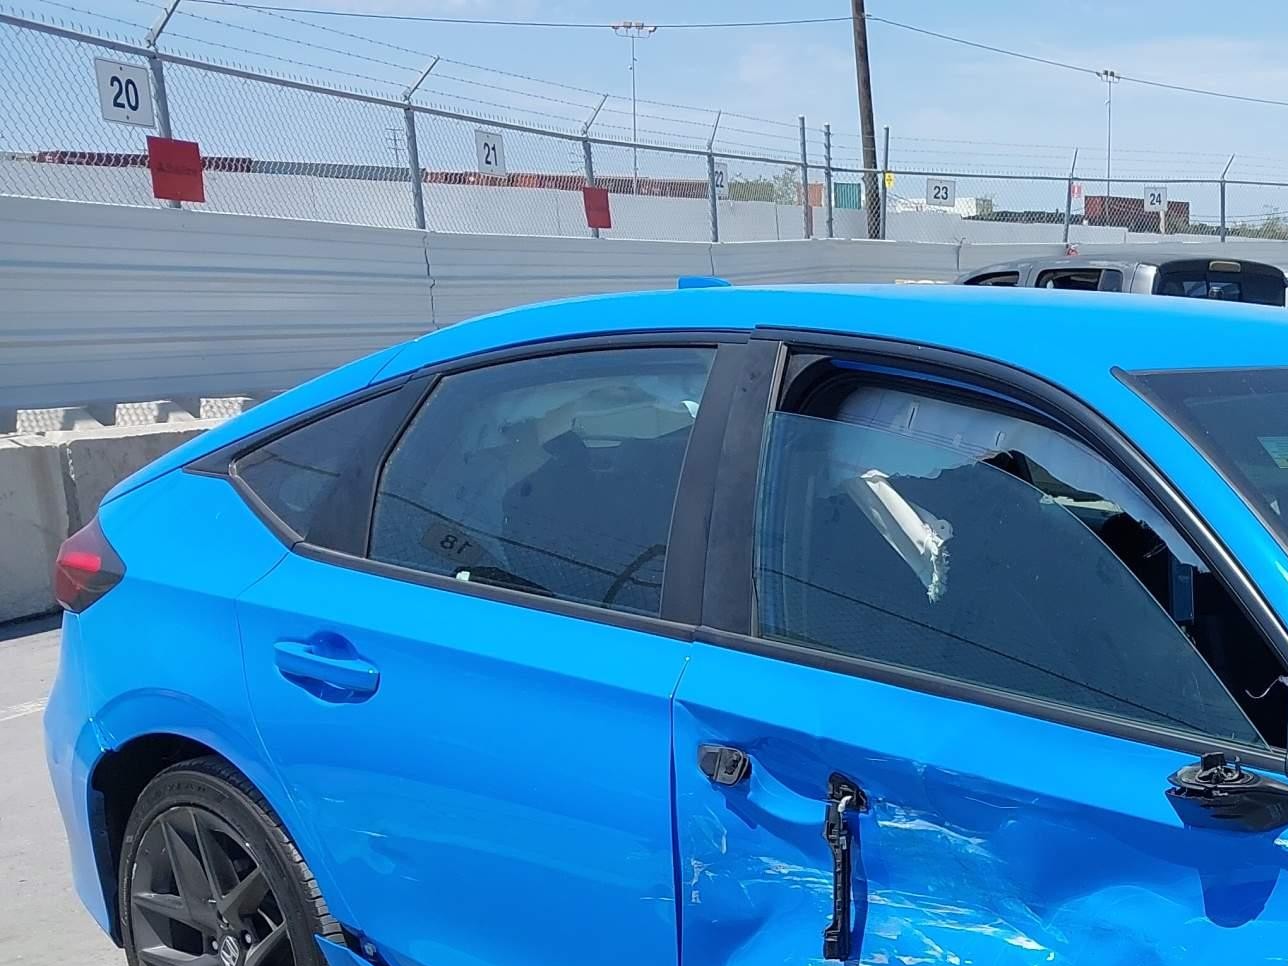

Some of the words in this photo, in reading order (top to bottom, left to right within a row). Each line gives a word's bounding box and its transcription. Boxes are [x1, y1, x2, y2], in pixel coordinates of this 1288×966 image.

[110, 75, 140, 112] 20
[483, 142, 498, 167] 21
[715, 170, 724, 188] 22
[933, 185, 949, 200] 23
[1150, 193, 1162, 206] 24
